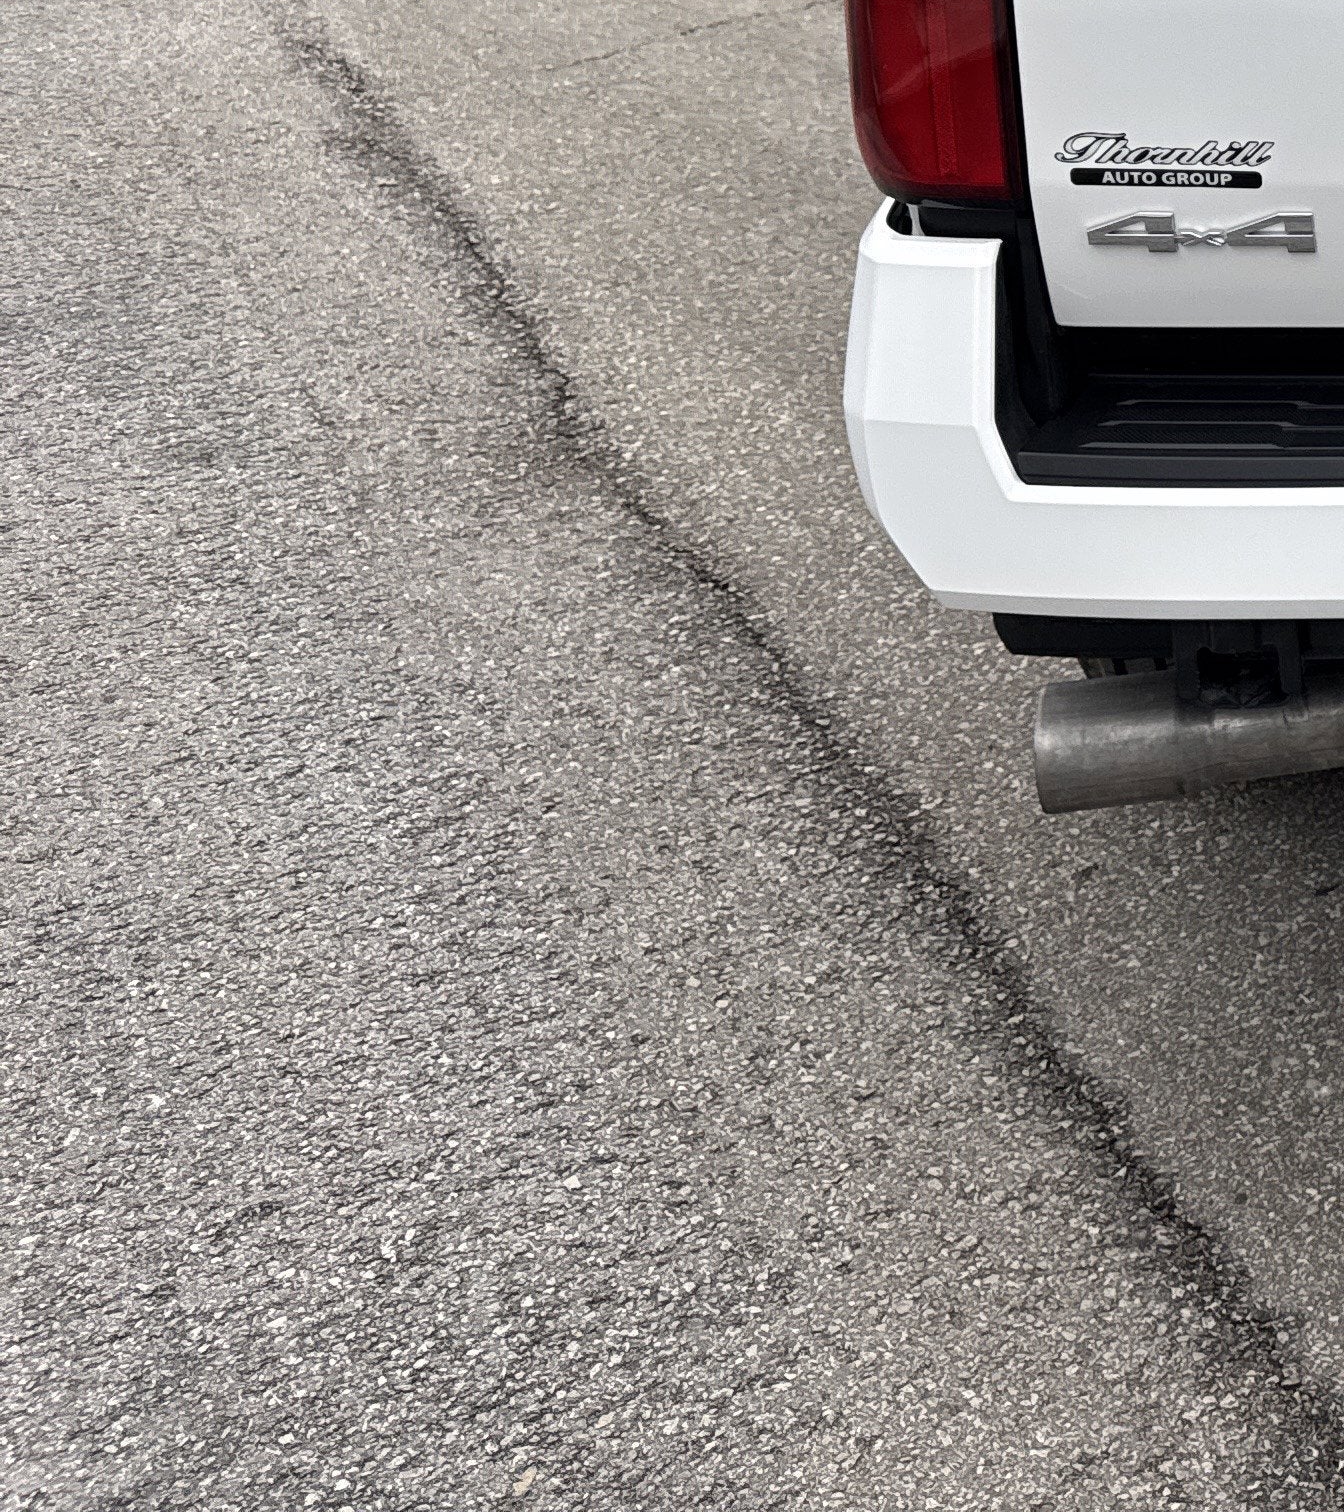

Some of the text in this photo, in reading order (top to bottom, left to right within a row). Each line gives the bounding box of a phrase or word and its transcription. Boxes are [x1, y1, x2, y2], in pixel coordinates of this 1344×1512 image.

[1054, 131, 1275, 168] Thornhill
[1101, 170, 1234, 188] AUTO GROUP
